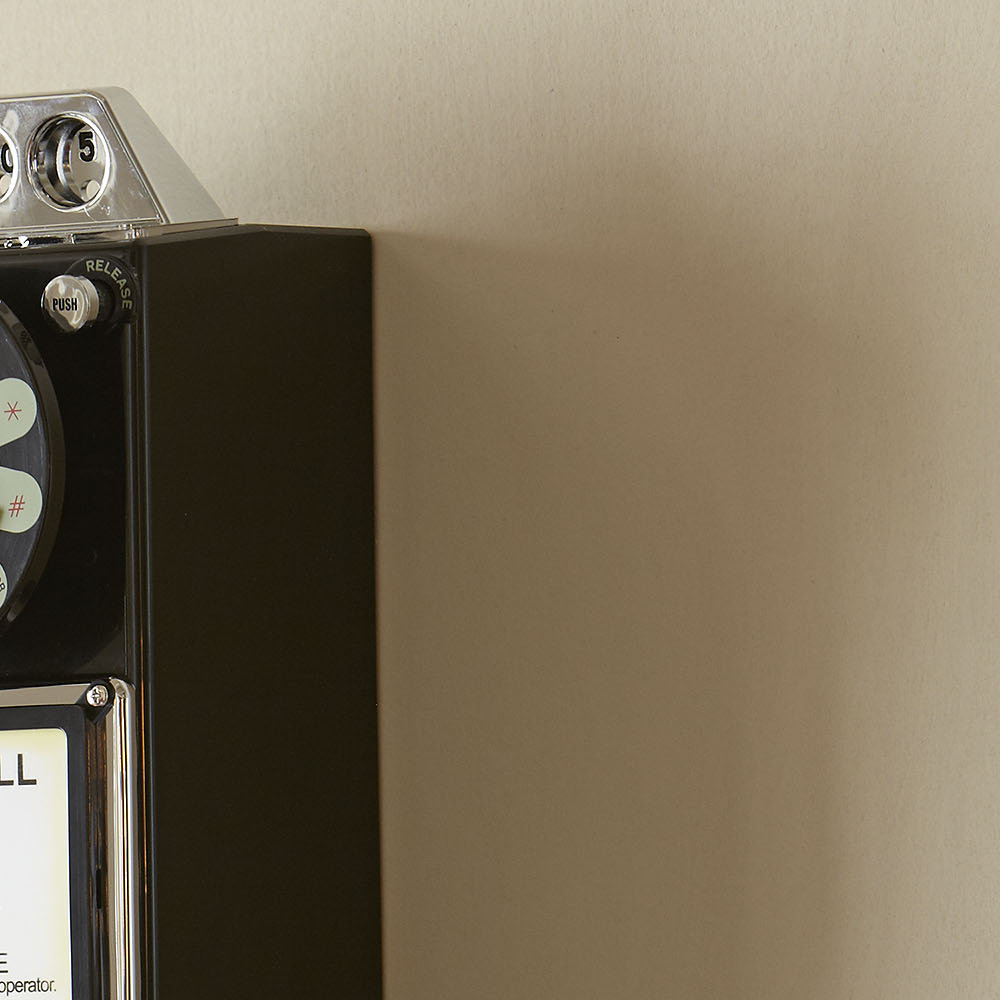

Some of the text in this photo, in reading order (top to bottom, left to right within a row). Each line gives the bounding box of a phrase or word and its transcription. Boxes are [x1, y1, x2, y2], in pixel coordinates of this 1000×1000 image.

[78, 131, 96, 162] 5
[85, 259, 133, 311] RELEASE
[52, 297, 79, 312] PUSH
